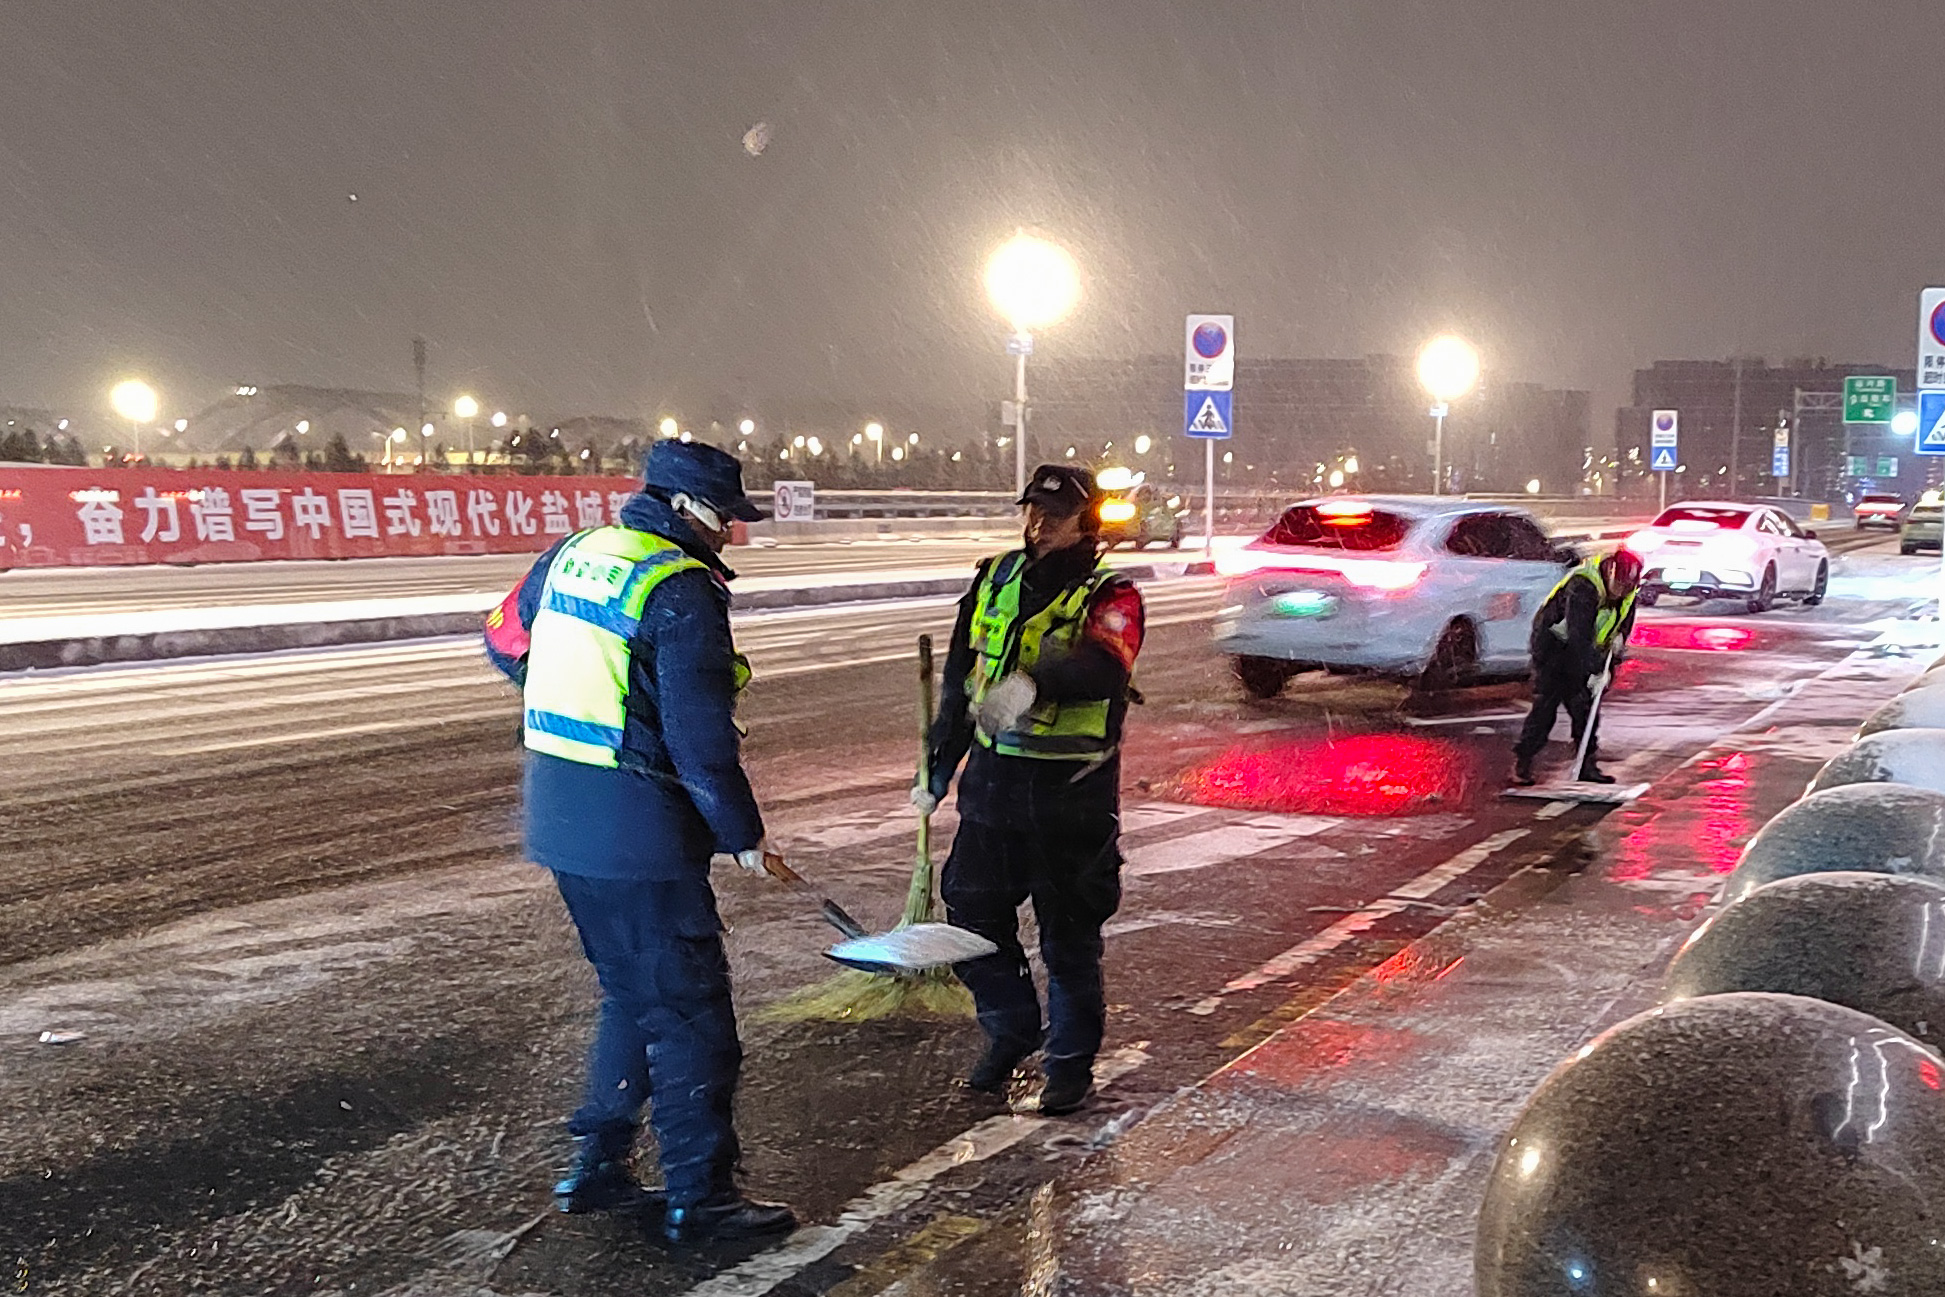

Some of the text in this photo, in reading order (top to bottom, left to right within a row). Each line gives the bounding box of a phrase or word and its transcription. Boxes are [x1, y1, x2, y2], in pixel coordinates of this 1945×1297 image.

[0, 486, 630, 547] ，奋力谱写中国式现代化盐城
